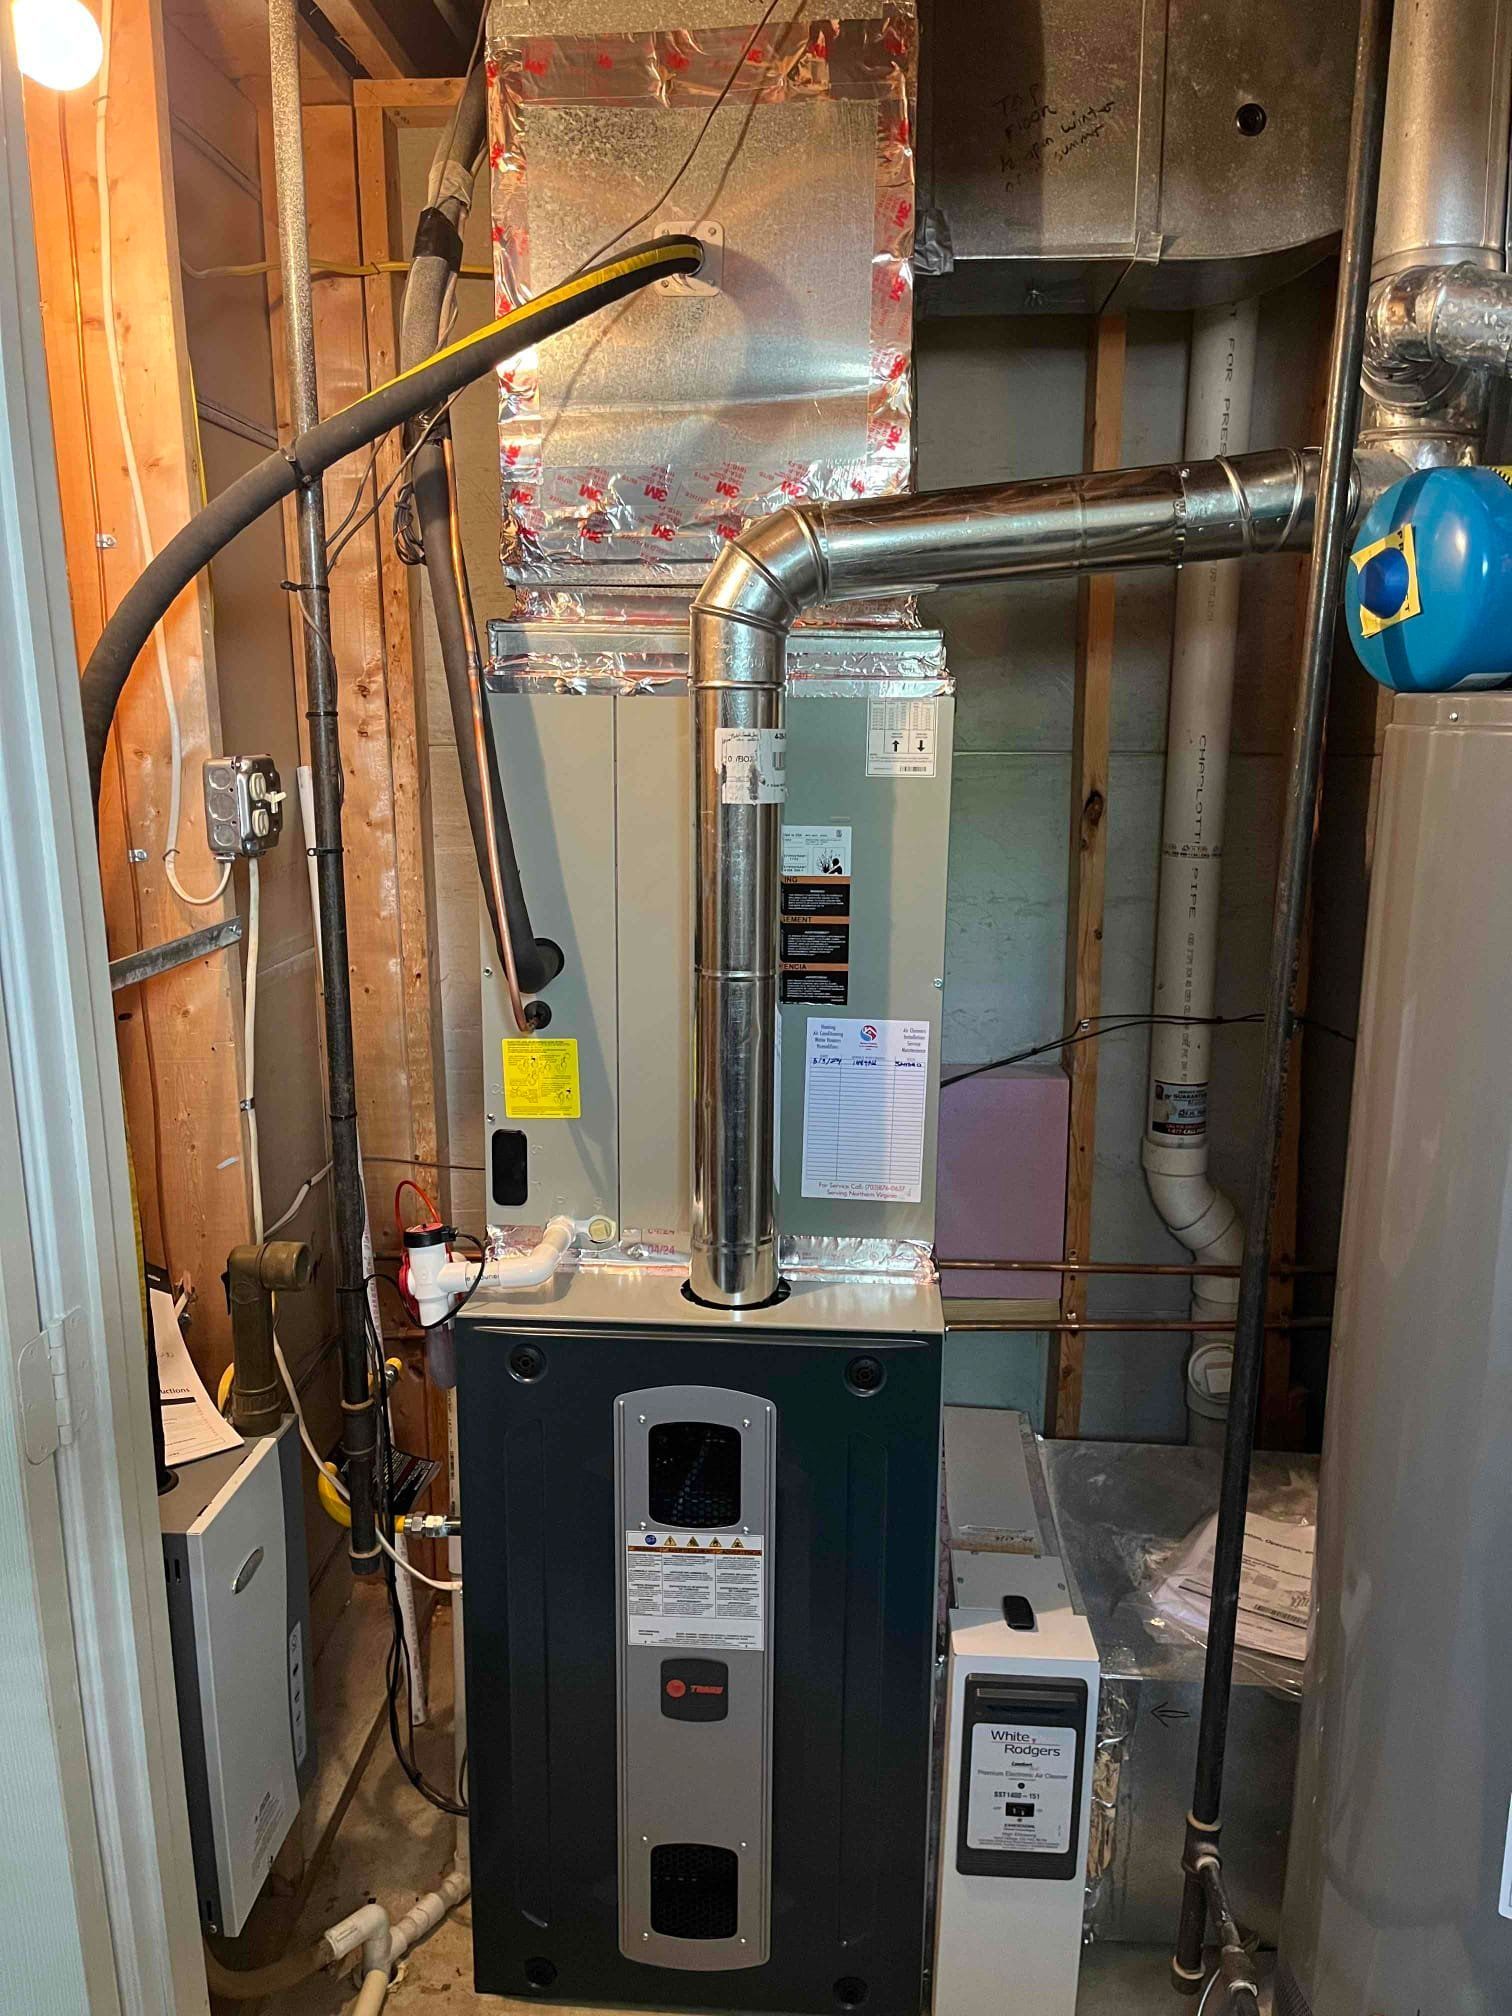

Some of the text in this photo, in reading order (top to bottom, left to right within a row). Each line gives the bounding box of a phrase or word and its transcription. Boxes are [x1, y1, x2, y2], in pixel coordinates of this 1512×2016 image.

[644, 484, 668, 501] 3M
[716, 480, 740, 499] 3M
[651, 523, 676, 542] 3M
[1189, 868, 1199, 919] PIPE
[827, 1189, 848, 1197] Serving
[647, 1244, 675, 1255] 04/24
[991, 1730, 1030, 1742] White
[1004, 1743, 1061, 1757] Rodgers
